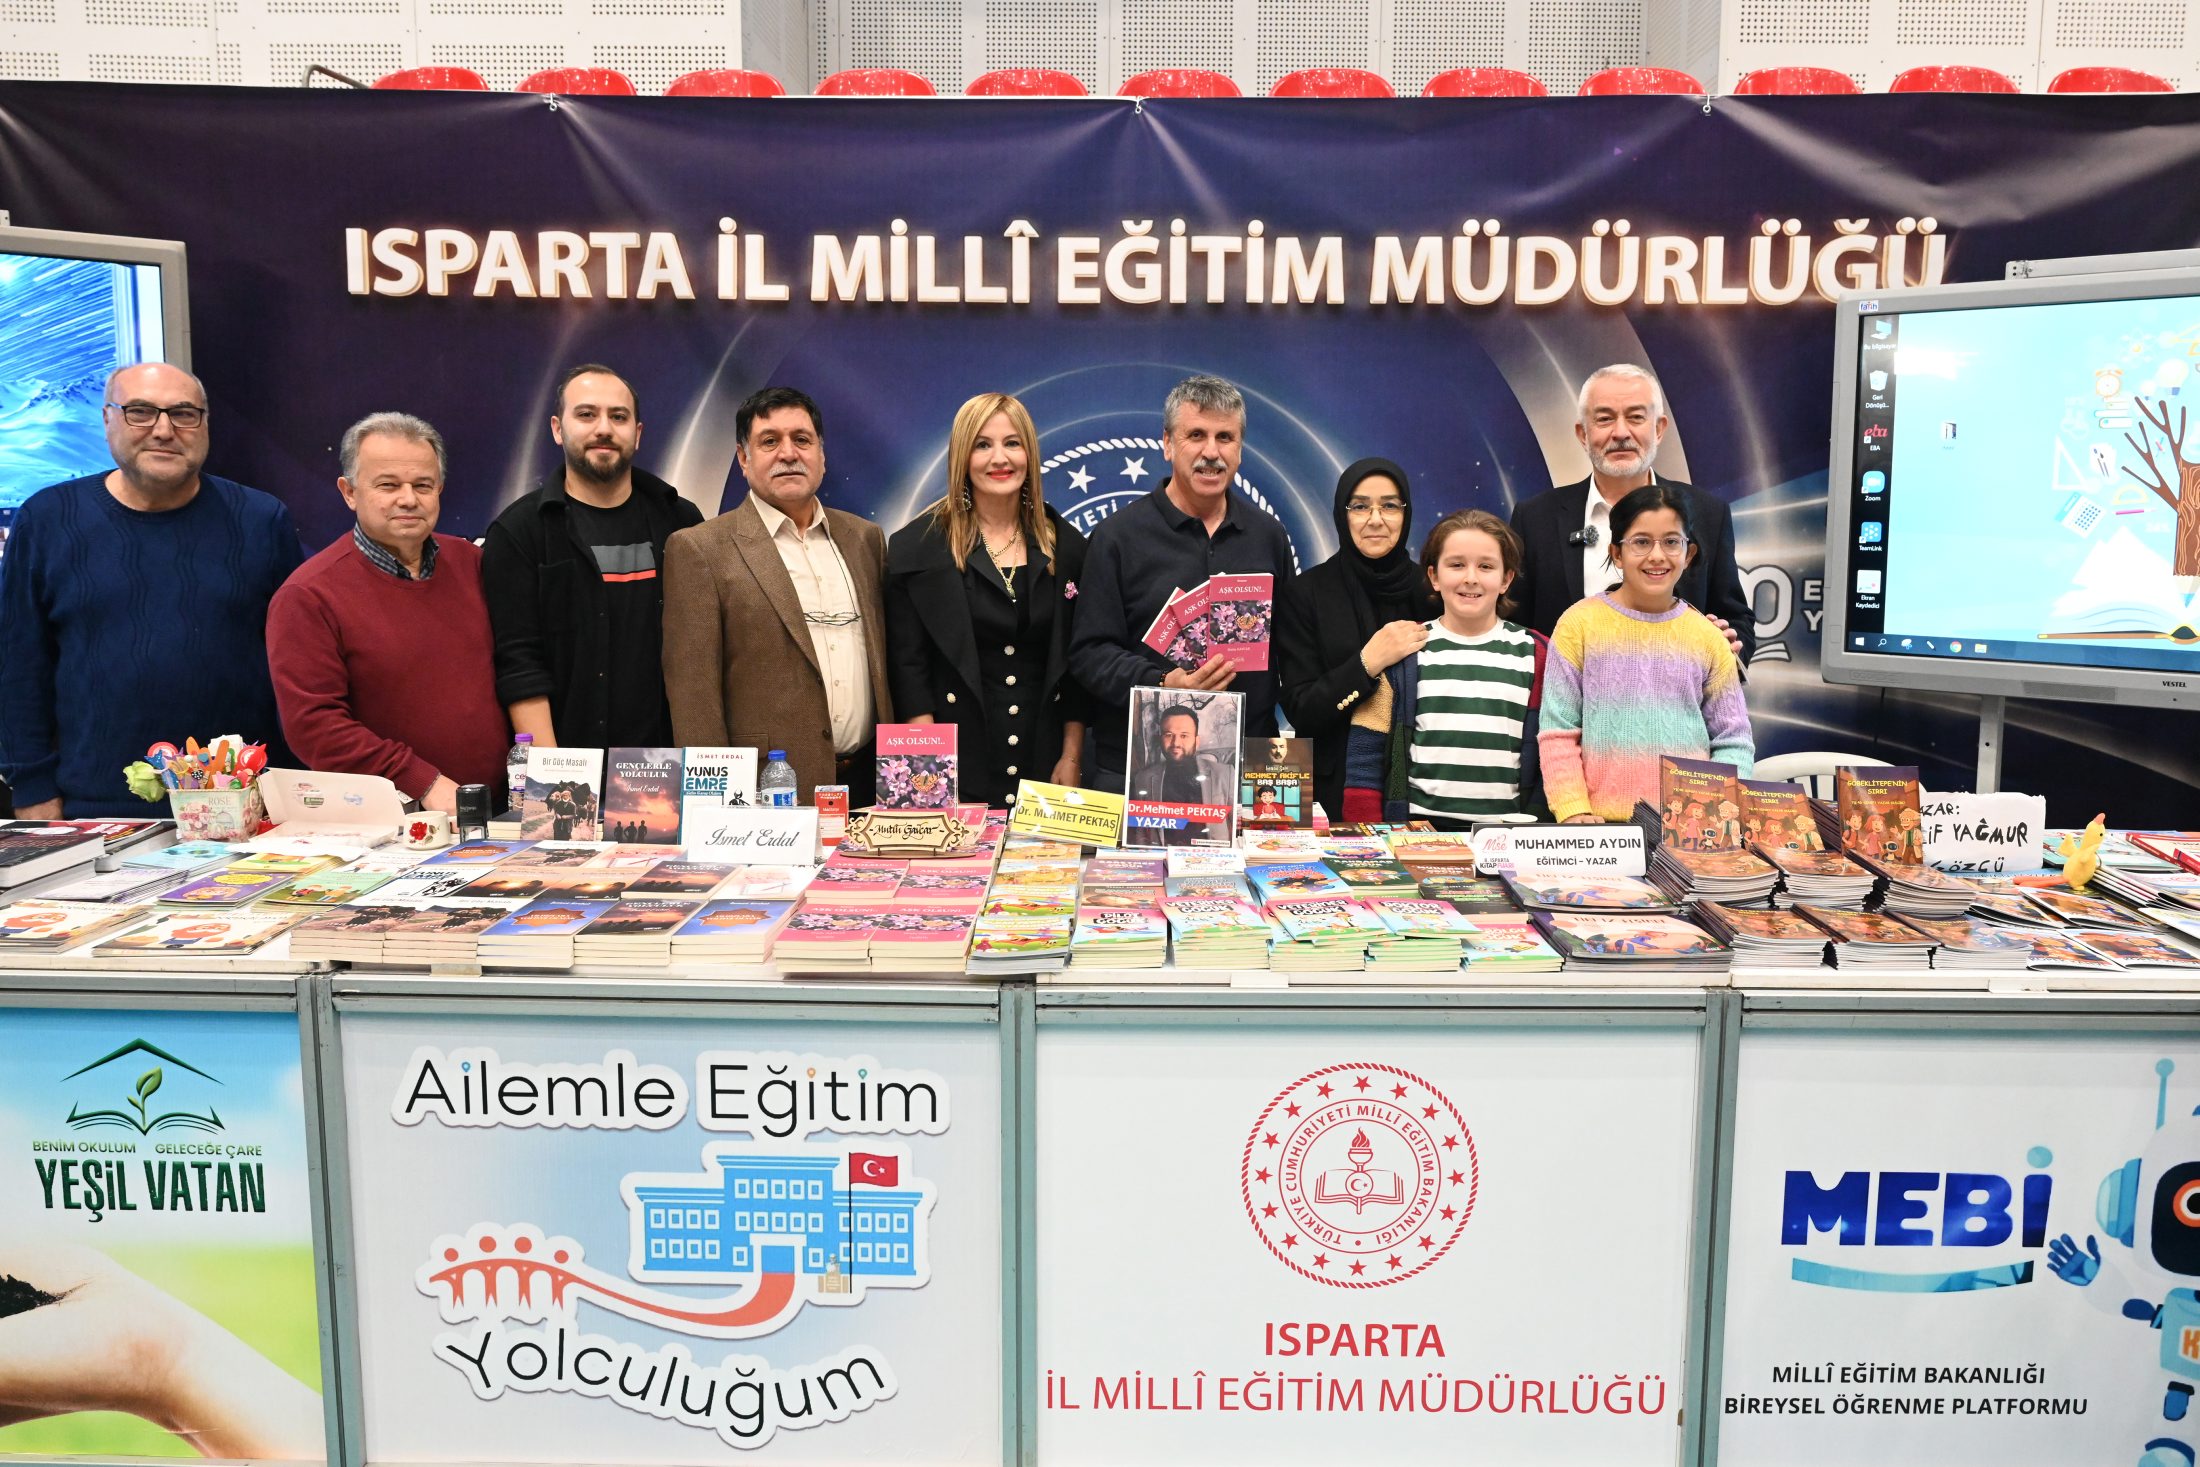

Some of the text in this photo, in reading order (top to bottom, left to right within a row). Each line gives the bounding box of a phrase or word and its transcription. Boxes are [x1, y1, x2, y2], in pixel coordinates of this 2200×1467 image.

[345, 217, 1947, 307] ISPARTA İL MİLLÎ EĞİTİM MÜDÜRLÜĞÜ
[1219, 586, 1234, 594] AŞK
[1184, 602, 1197, 616] AŞK
[1157, 630, 1168, 644] AŞK
[2162, 680, 2188, 688] VESTEL
[886, 737, 904, 747] AŞK
[542, 757, 551, 767] Bir
[552, 758, 565, 769] Göç
[616, 762, 672, 771] GENÇLERLE
[619, 770, 669, 778] YOLCULUK
[686, 766, 729, 777] YUNUS
[1244, 772, 1278, 780] MEHMET
[686, 777, 728, 790] EMRE
[1257, 779, 1298, 787] BAŞ BAŞA
[1018, 805, 1117, 832] Dr. MEHMET PEKTAŞ
[1128, 803, 1227, 820] Dr.Mehmet PEKTAŞ
[1135, 816, 1178, 829] YAZAR
[705, 824, 800, 848] İsmet Erdal
[1953, 818, 2028, 847] YAĞMUR
[1515, 838, 1642, 849] MUHAMMED AYDIN
[1536, 855, 1577, 866] EĞİTİMCİ
[1585, 857, 1618, 866] YAZAR
[405, 1059, 676, 1118] Ailemle
[709, 1063, 938, 1139] Eğitim
[33, 1140, 137, 1154] BENİM OKULUM
[155, 1141, 263, 1159] GELECEĞE ÇARE
[1285, 1102, 1435, 1246] TÜRKİYE CUMHURİYETİ MİLLÎ EĞİTİM BAKANLIĞI
[34, 1158, 266, 1223] YEŞİL VATAN
[1264, 1322, 1446, 1358] ISPARTA
[1772, 1361, 2046, 1385] MİLLÎ EĞİTİM BAKANLIĞI
[446, 1328, 885, 1438] Yolculuğum
[1046, 1368, 1666, 1416] İL MİLLÎ EĞİTİM MÜDÜRLÜĞÜ
[1724, 1392, 2089, 1416] BİREYSEL ÖĞRENME PLATFORMU
